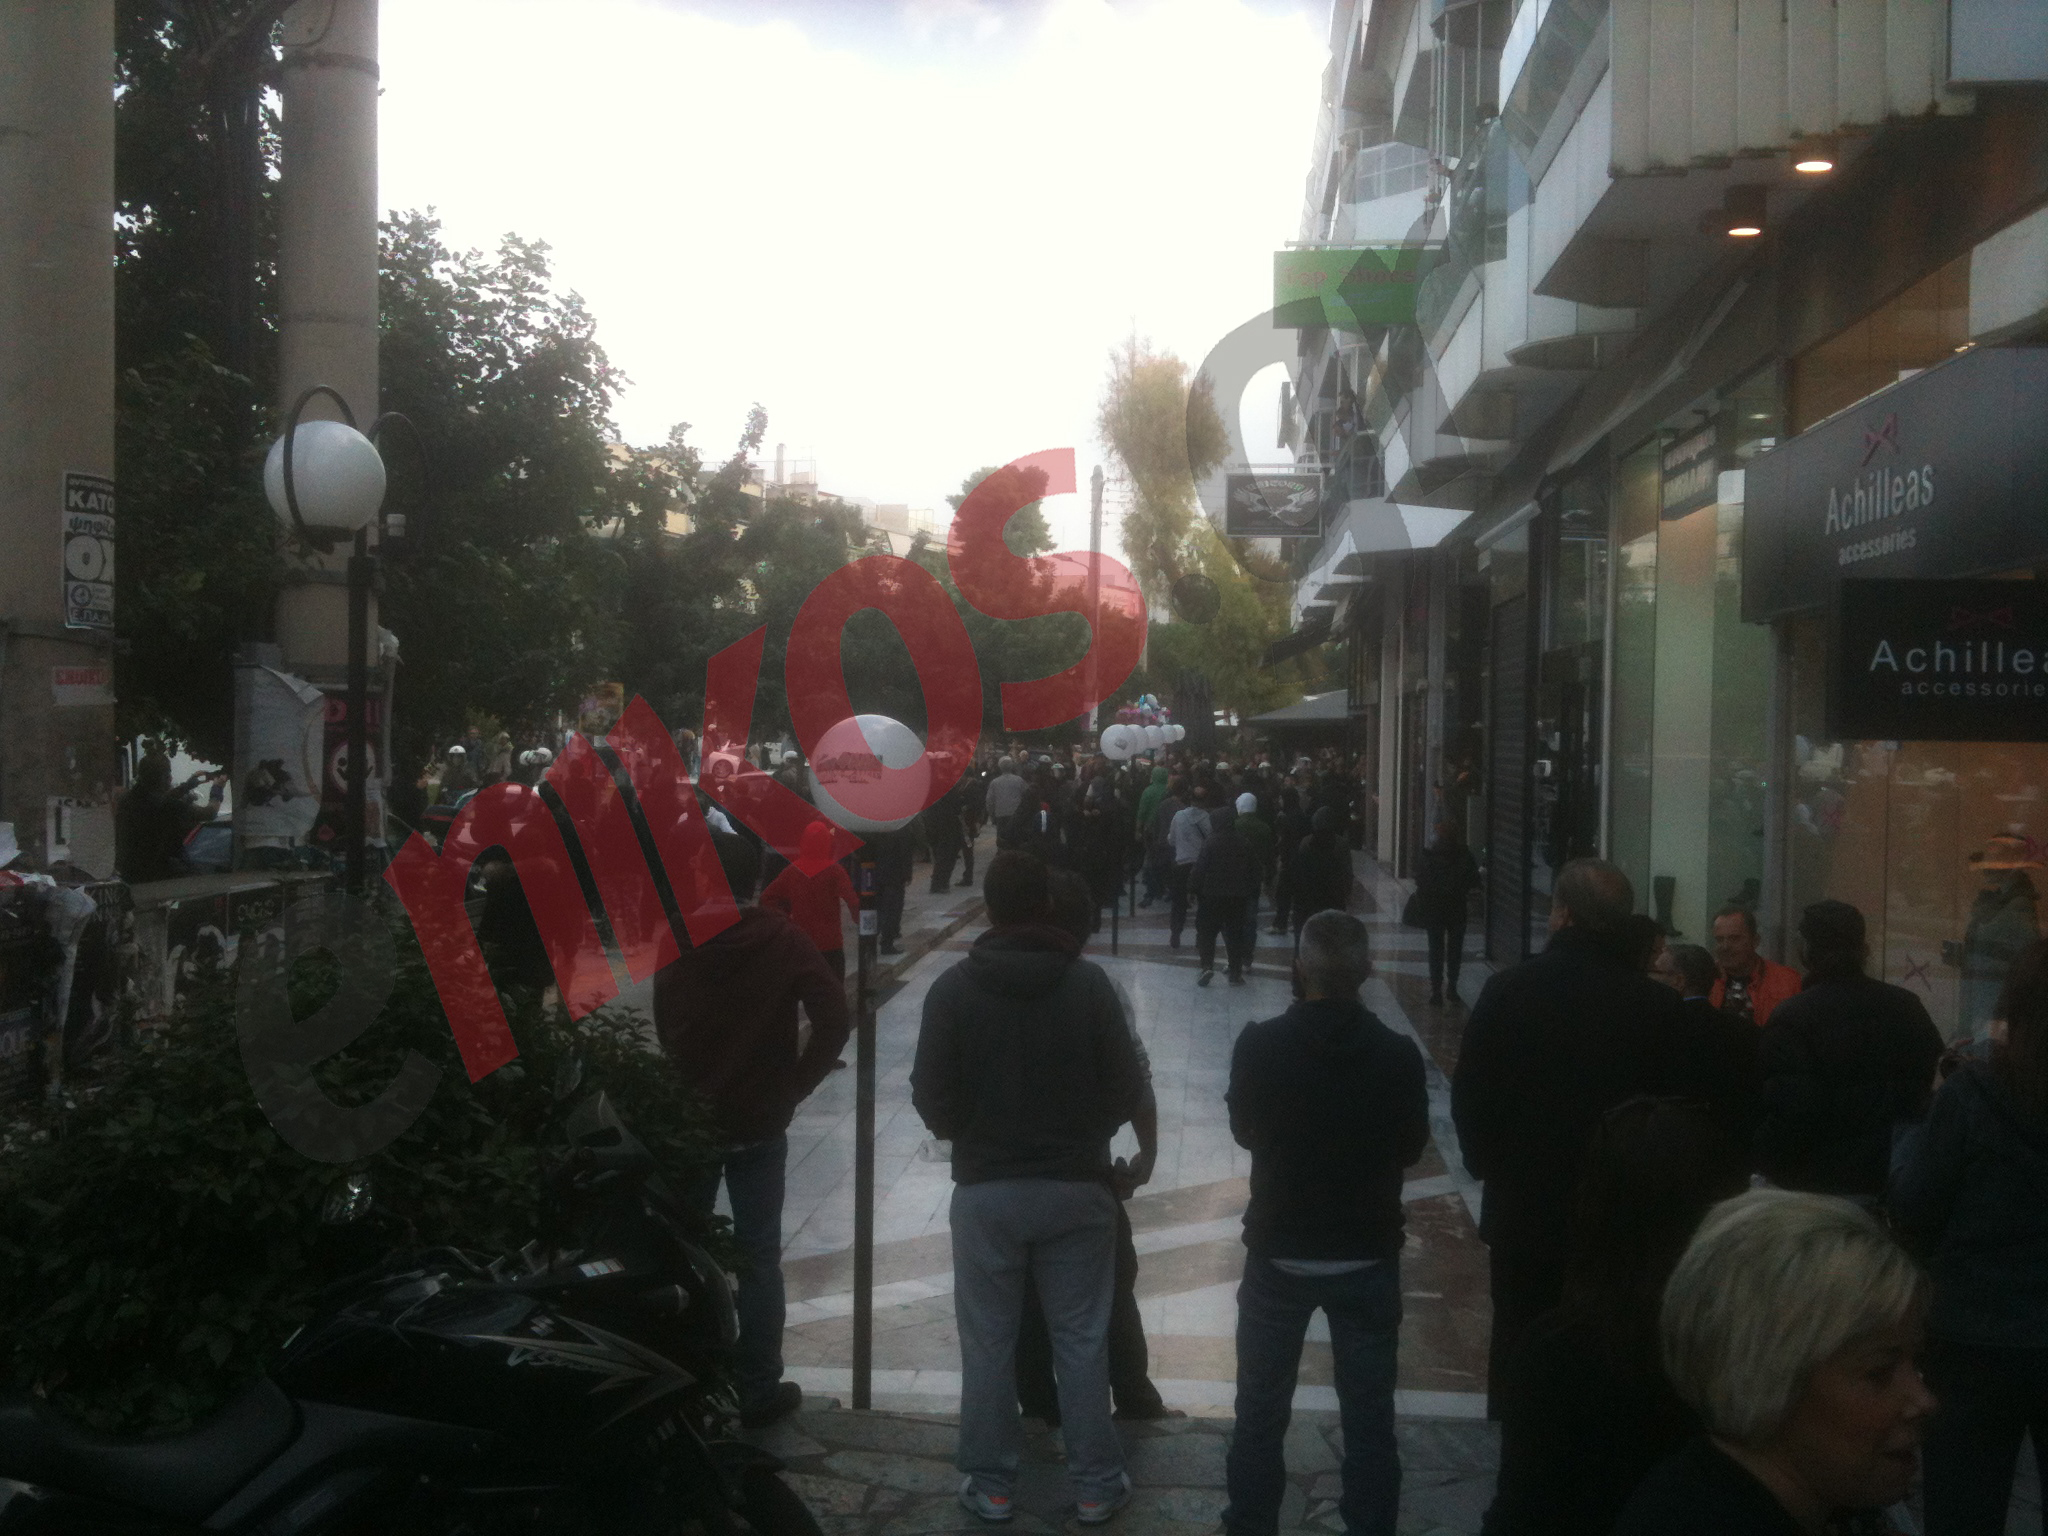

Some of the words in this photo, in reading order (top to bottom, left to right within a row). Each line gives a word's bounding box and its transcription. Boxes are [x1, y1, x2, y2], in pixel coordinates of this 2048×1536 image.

[1825, 464, 1935, 536] Achilleas
[1838, 526, 1917, 567] accessories
[1869, 640, 2048, 674] Achille
